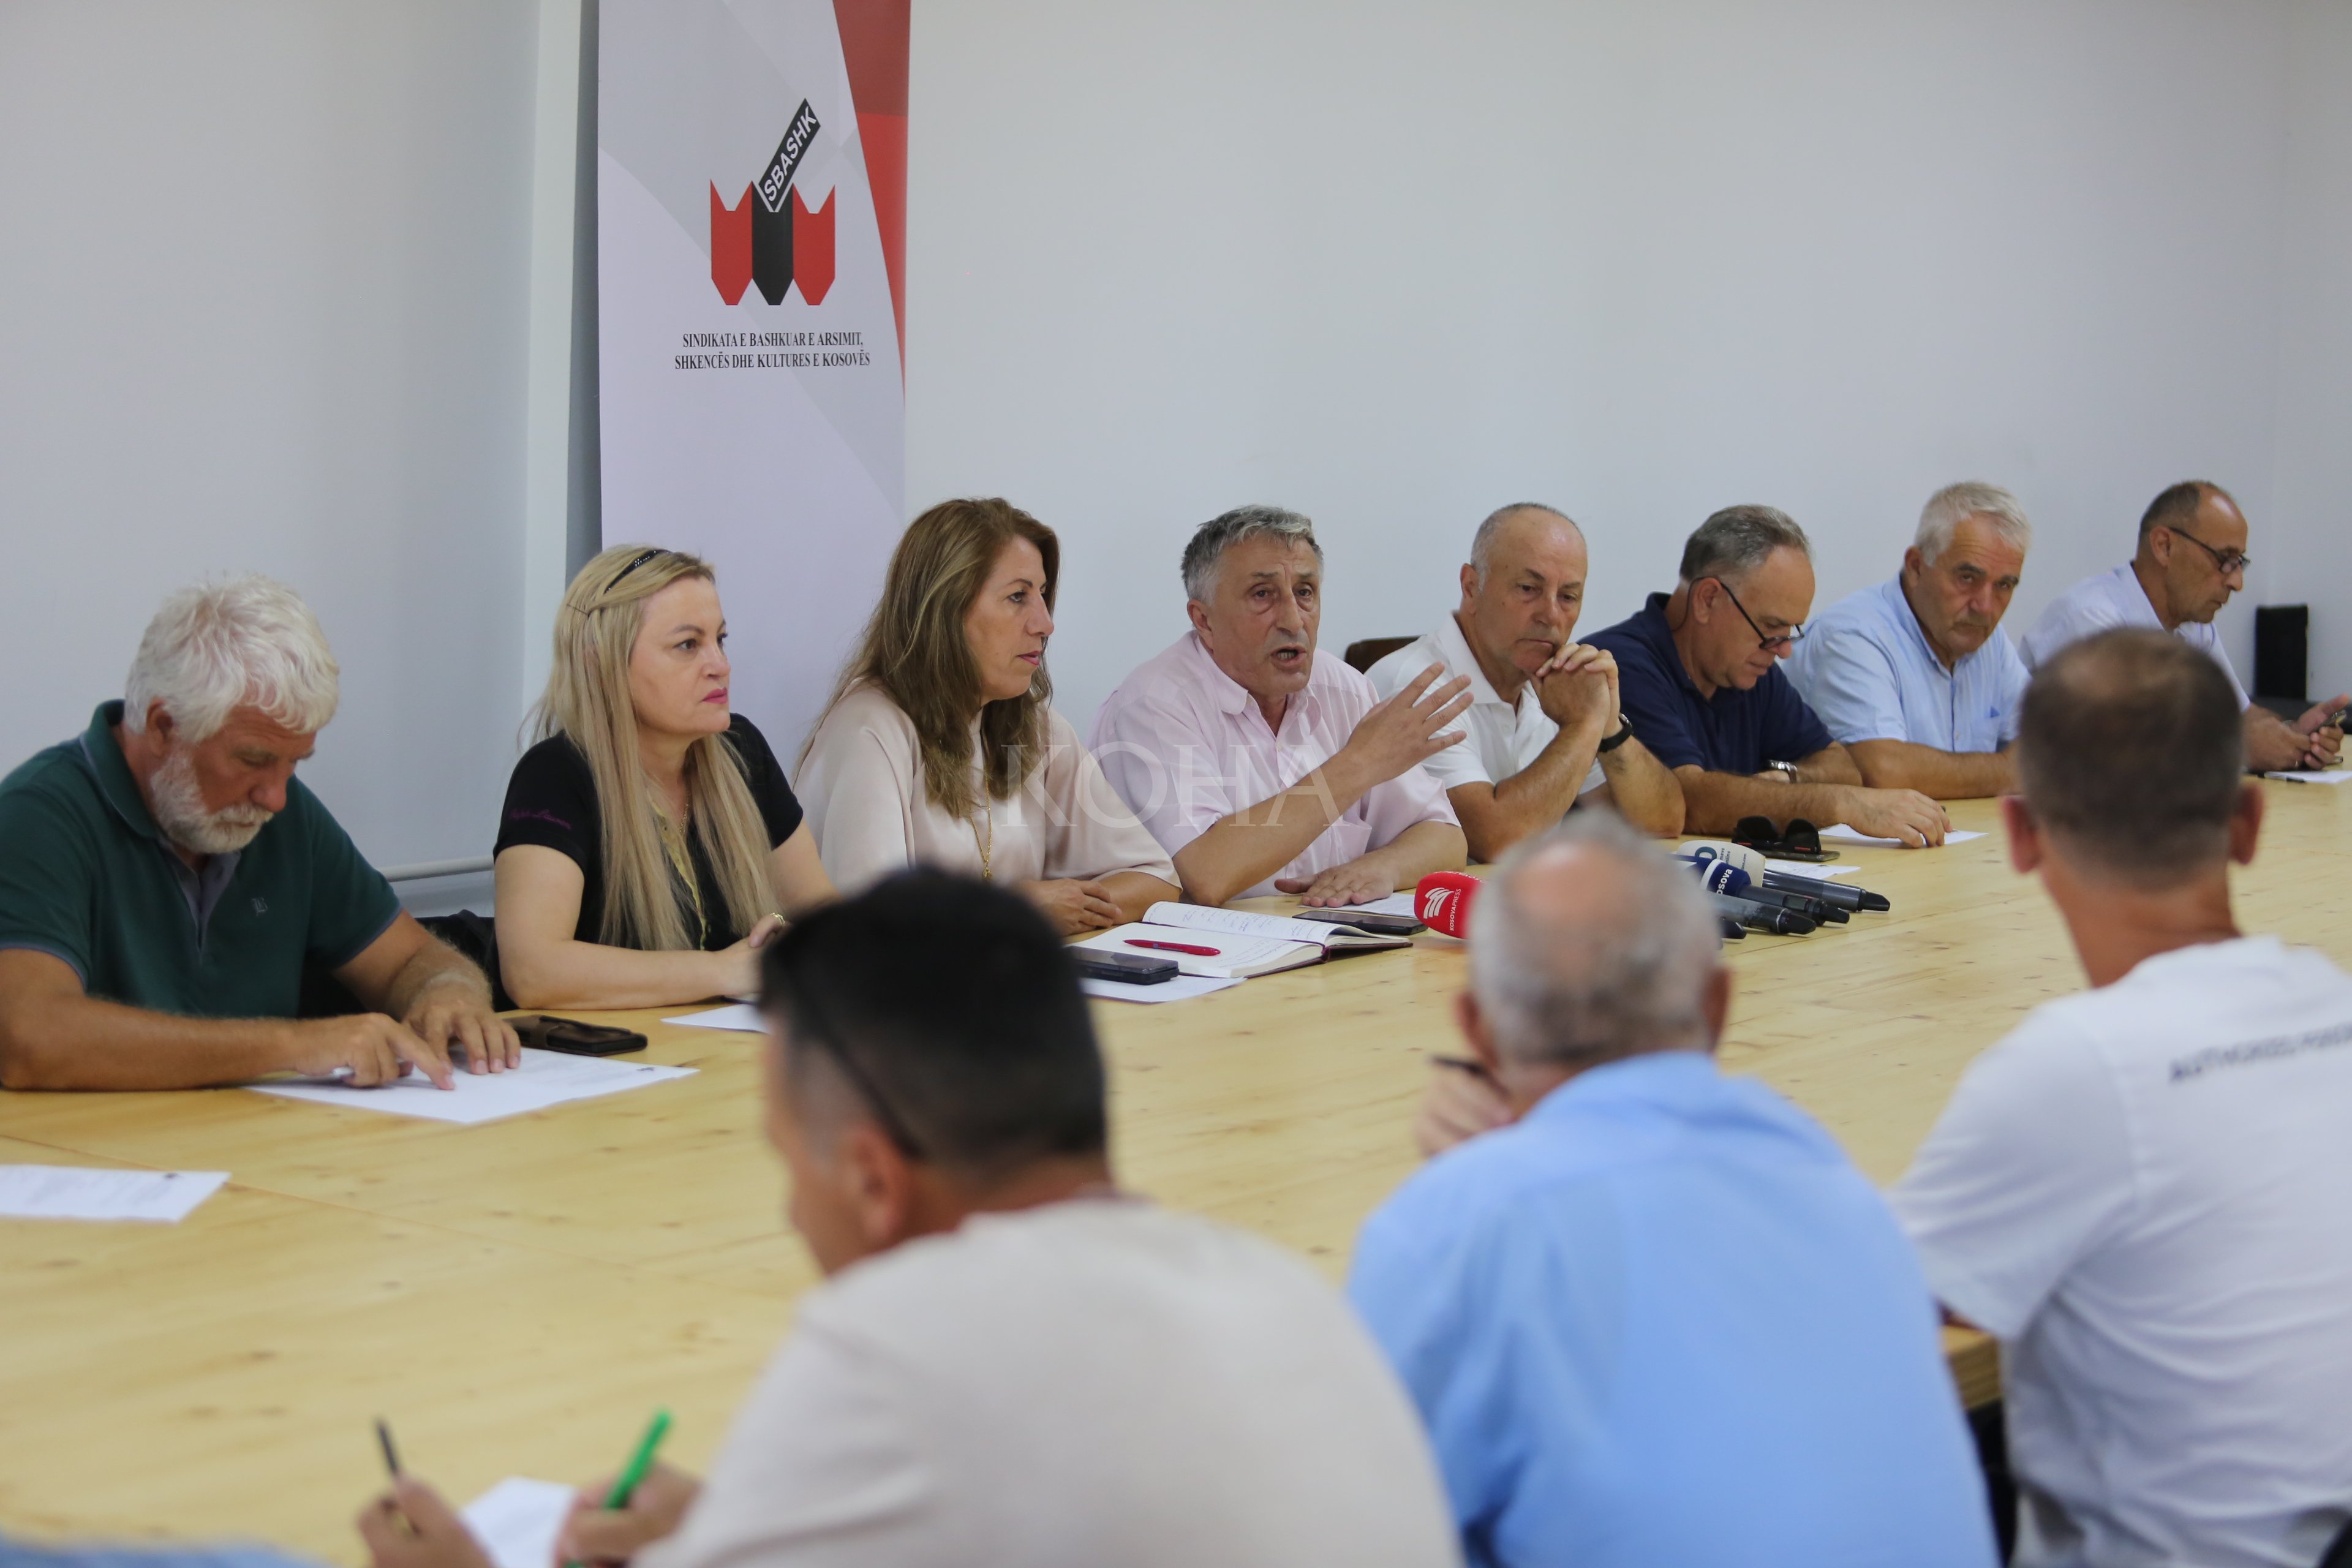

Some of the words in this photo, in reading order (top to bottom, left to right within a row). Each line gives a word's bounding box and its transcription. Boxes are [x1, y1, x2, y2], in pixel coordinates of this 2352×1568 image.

[764, 106, 816, 202] SBASHK
[683, 333, 738, 347] SINDIKATA
[740, 333, 747, 347] E
[750, 332, 806, 347] BASHKUAR
[809, 332, 815, 346] E
[817, 331, 864, 347] ARSIMIT,
[675, 351, 730, 369] SHKENCËS
[733, 354, 755, 368] DHE
[758, 353, 810, 368] KULTURES
[813, 353, 820, 366] E
[823, 349, 870, 366] KOSOVËS
[1716, 869, 1733, 895] osova
[1449, 888, 1461, 931] KOSOVAPRESS
